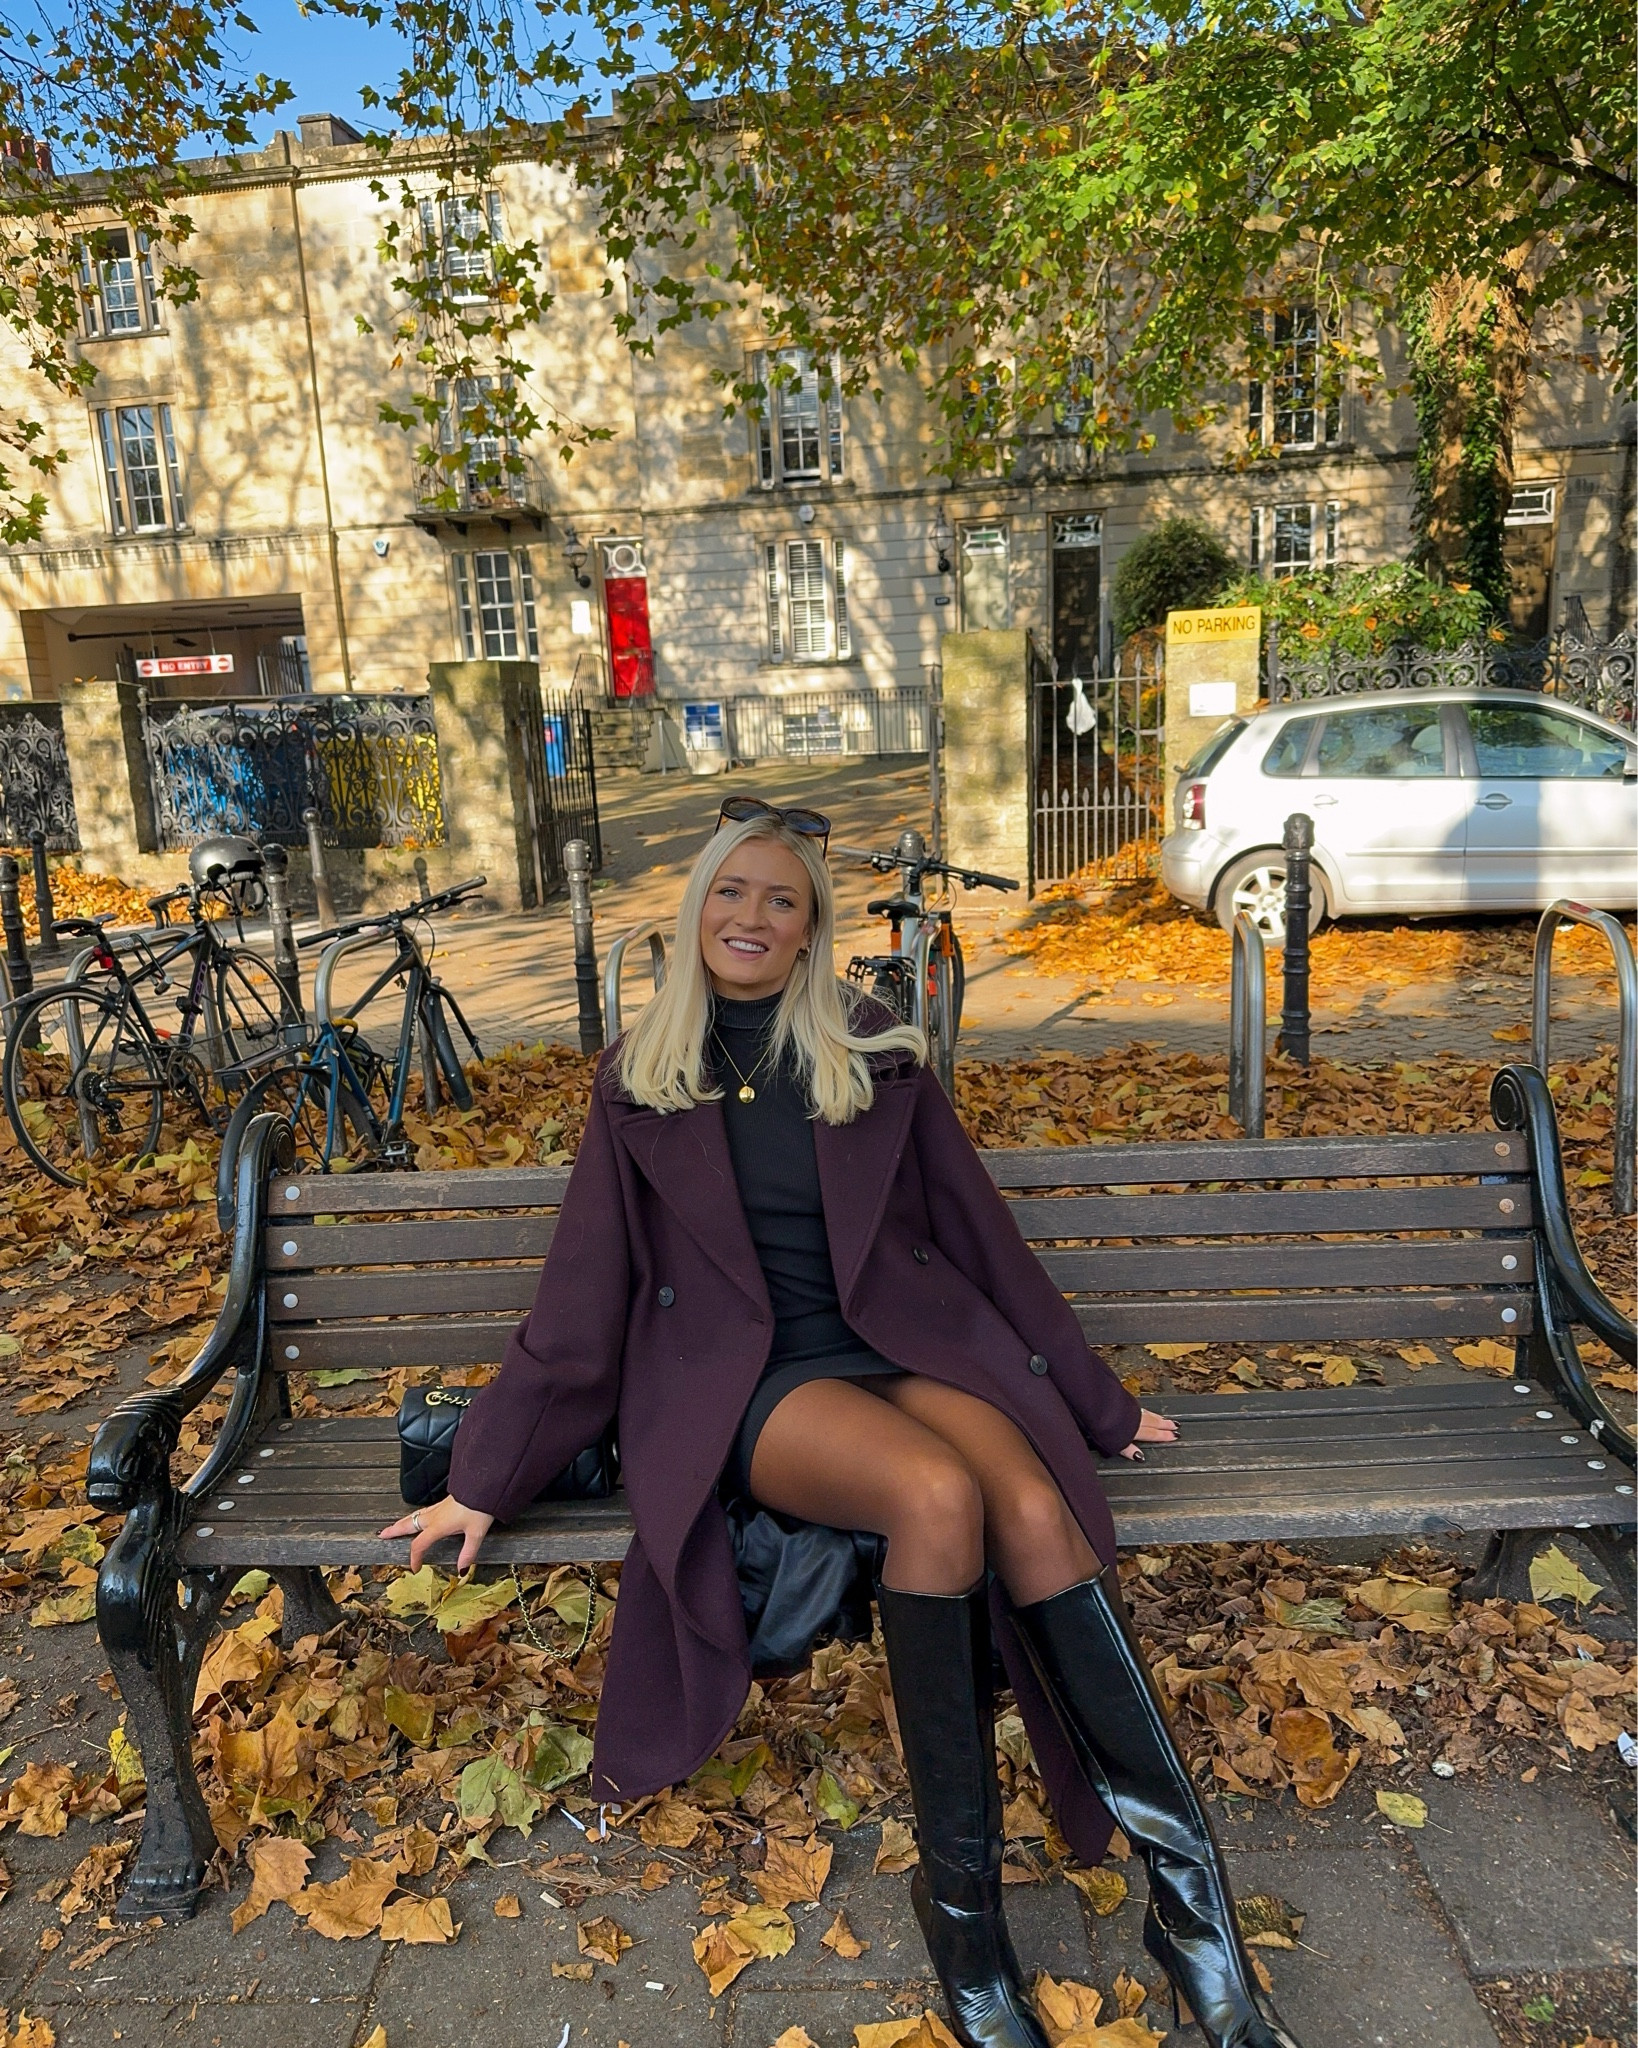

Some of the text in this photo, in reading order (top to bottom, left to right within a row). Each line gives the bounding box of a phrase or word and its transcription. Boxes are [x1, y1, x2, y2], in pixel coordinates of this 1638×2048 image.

[1173, 615, 1256, 635] NO PARKING
[161, 661, 208, 672] NO ENTRY
